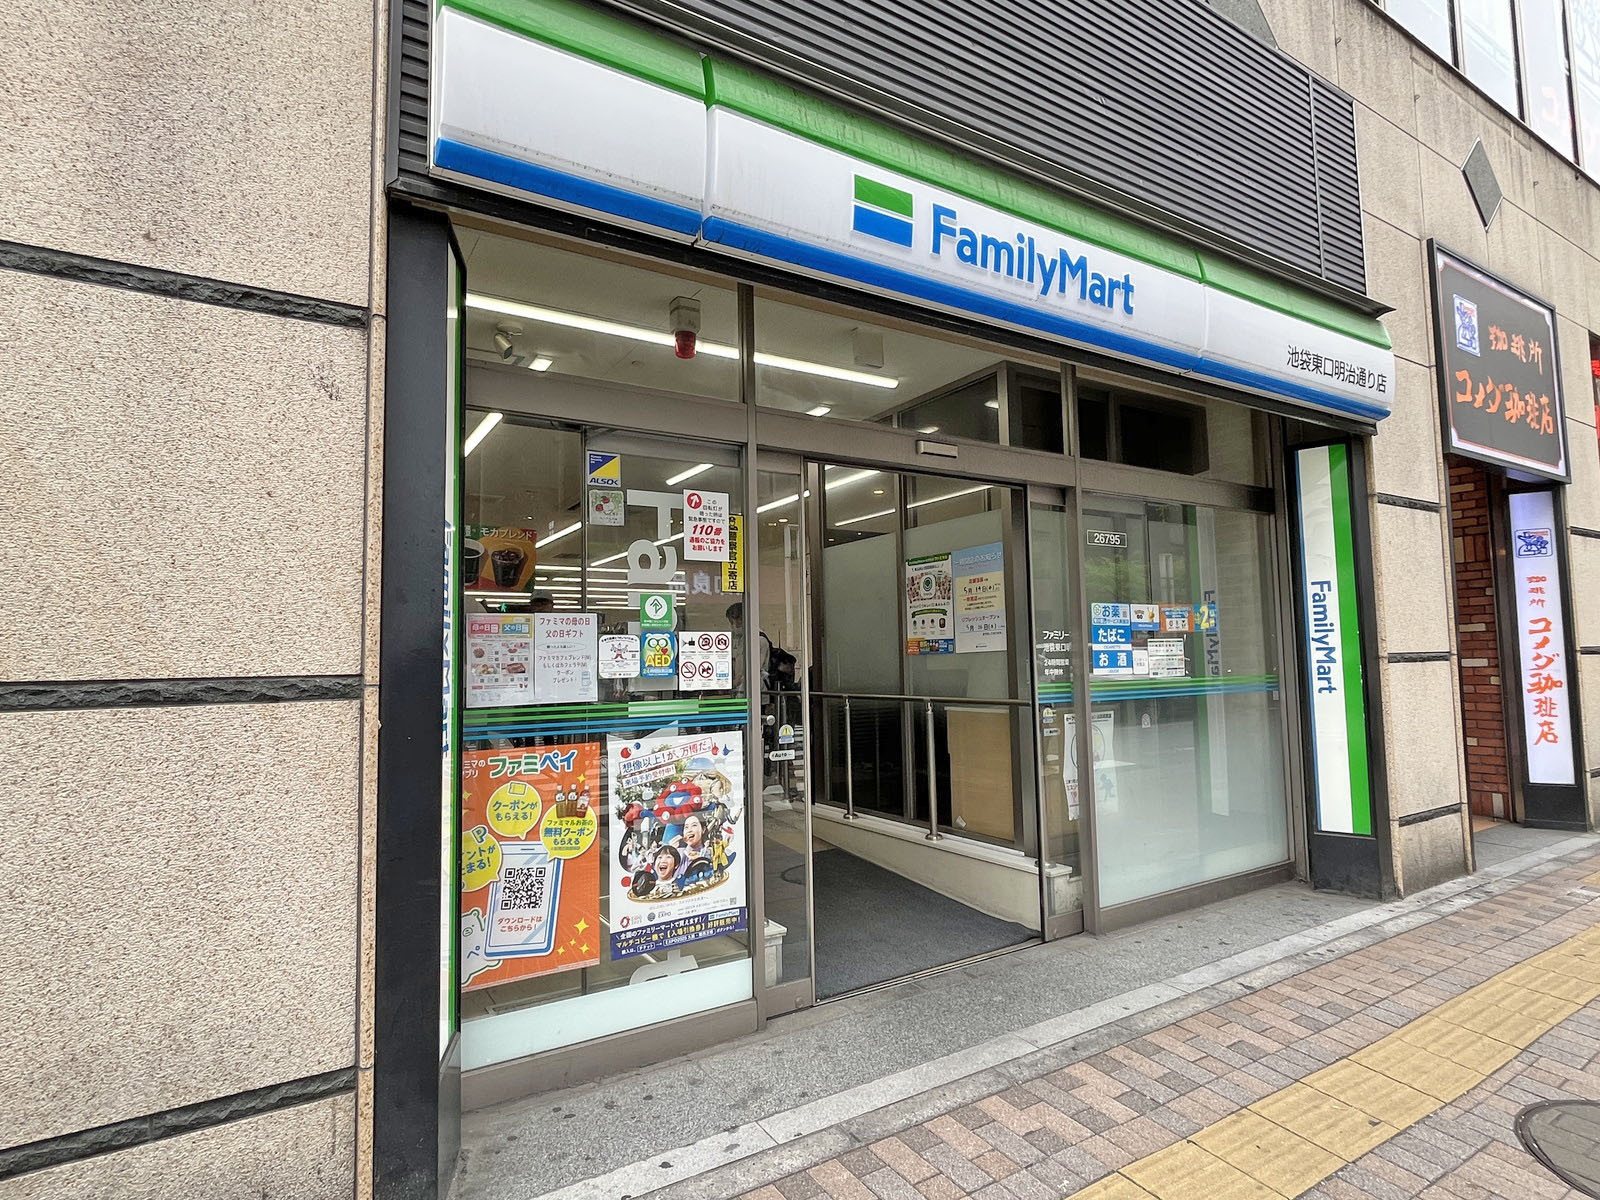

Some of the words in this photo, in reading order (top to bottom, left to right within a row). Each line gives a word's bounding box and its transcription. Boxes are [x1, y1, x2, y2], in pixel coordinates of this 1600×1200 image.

[931, 203, 1134, 315] FamilyMart
[1287, 345, 1387, 393] 池袋東口明治通り店
[1455, 369, 1554, 436] コメダ珈琲店
[589, 477, 619, 486] ALSOK
[480, 527, 533, 541] モカブレンド
[692, 524, 723, 536] 110番
[689, 536, 726, 545] 通報のご協力を
[1094, 533, 1121, 545] 26795
[692, 544, 723, 552] お願いします
[1102, 605, 1120, 618] お薬
[539, 617, 591, 626] ファミマの母の日
[546, 629, 584, 638] 父の日ギフト
[1042, 630, 1071, 640] ファミリー
[1098, 628, 1126, 642] たばこ
[1310, 580, 1337, 694] FamilyMart
[645, 654, 672, 667] AED
[1527, 617, 1563, 746] コメダ珈琲店
[488, 750, 578, 779] ファミペイ
[463, 770, 479, 779] プリ
[624, 766, 675, 787] 来場予約受付中!
[493, 799, 538, 811] クーポンが
[495, 812, 532, 821] もらえる!
[544, 827, 594, 838] 無料クーポン
[553, 838, 581, 846] もらえる
[462, 844, 496, 861] ントが
[462, 857, 491, 876] まる!
[498, 916, 543, 925] ダウンロードは
[500, 924, 537, 933] こちらから!
[467, 945, 481, 959] ペ
